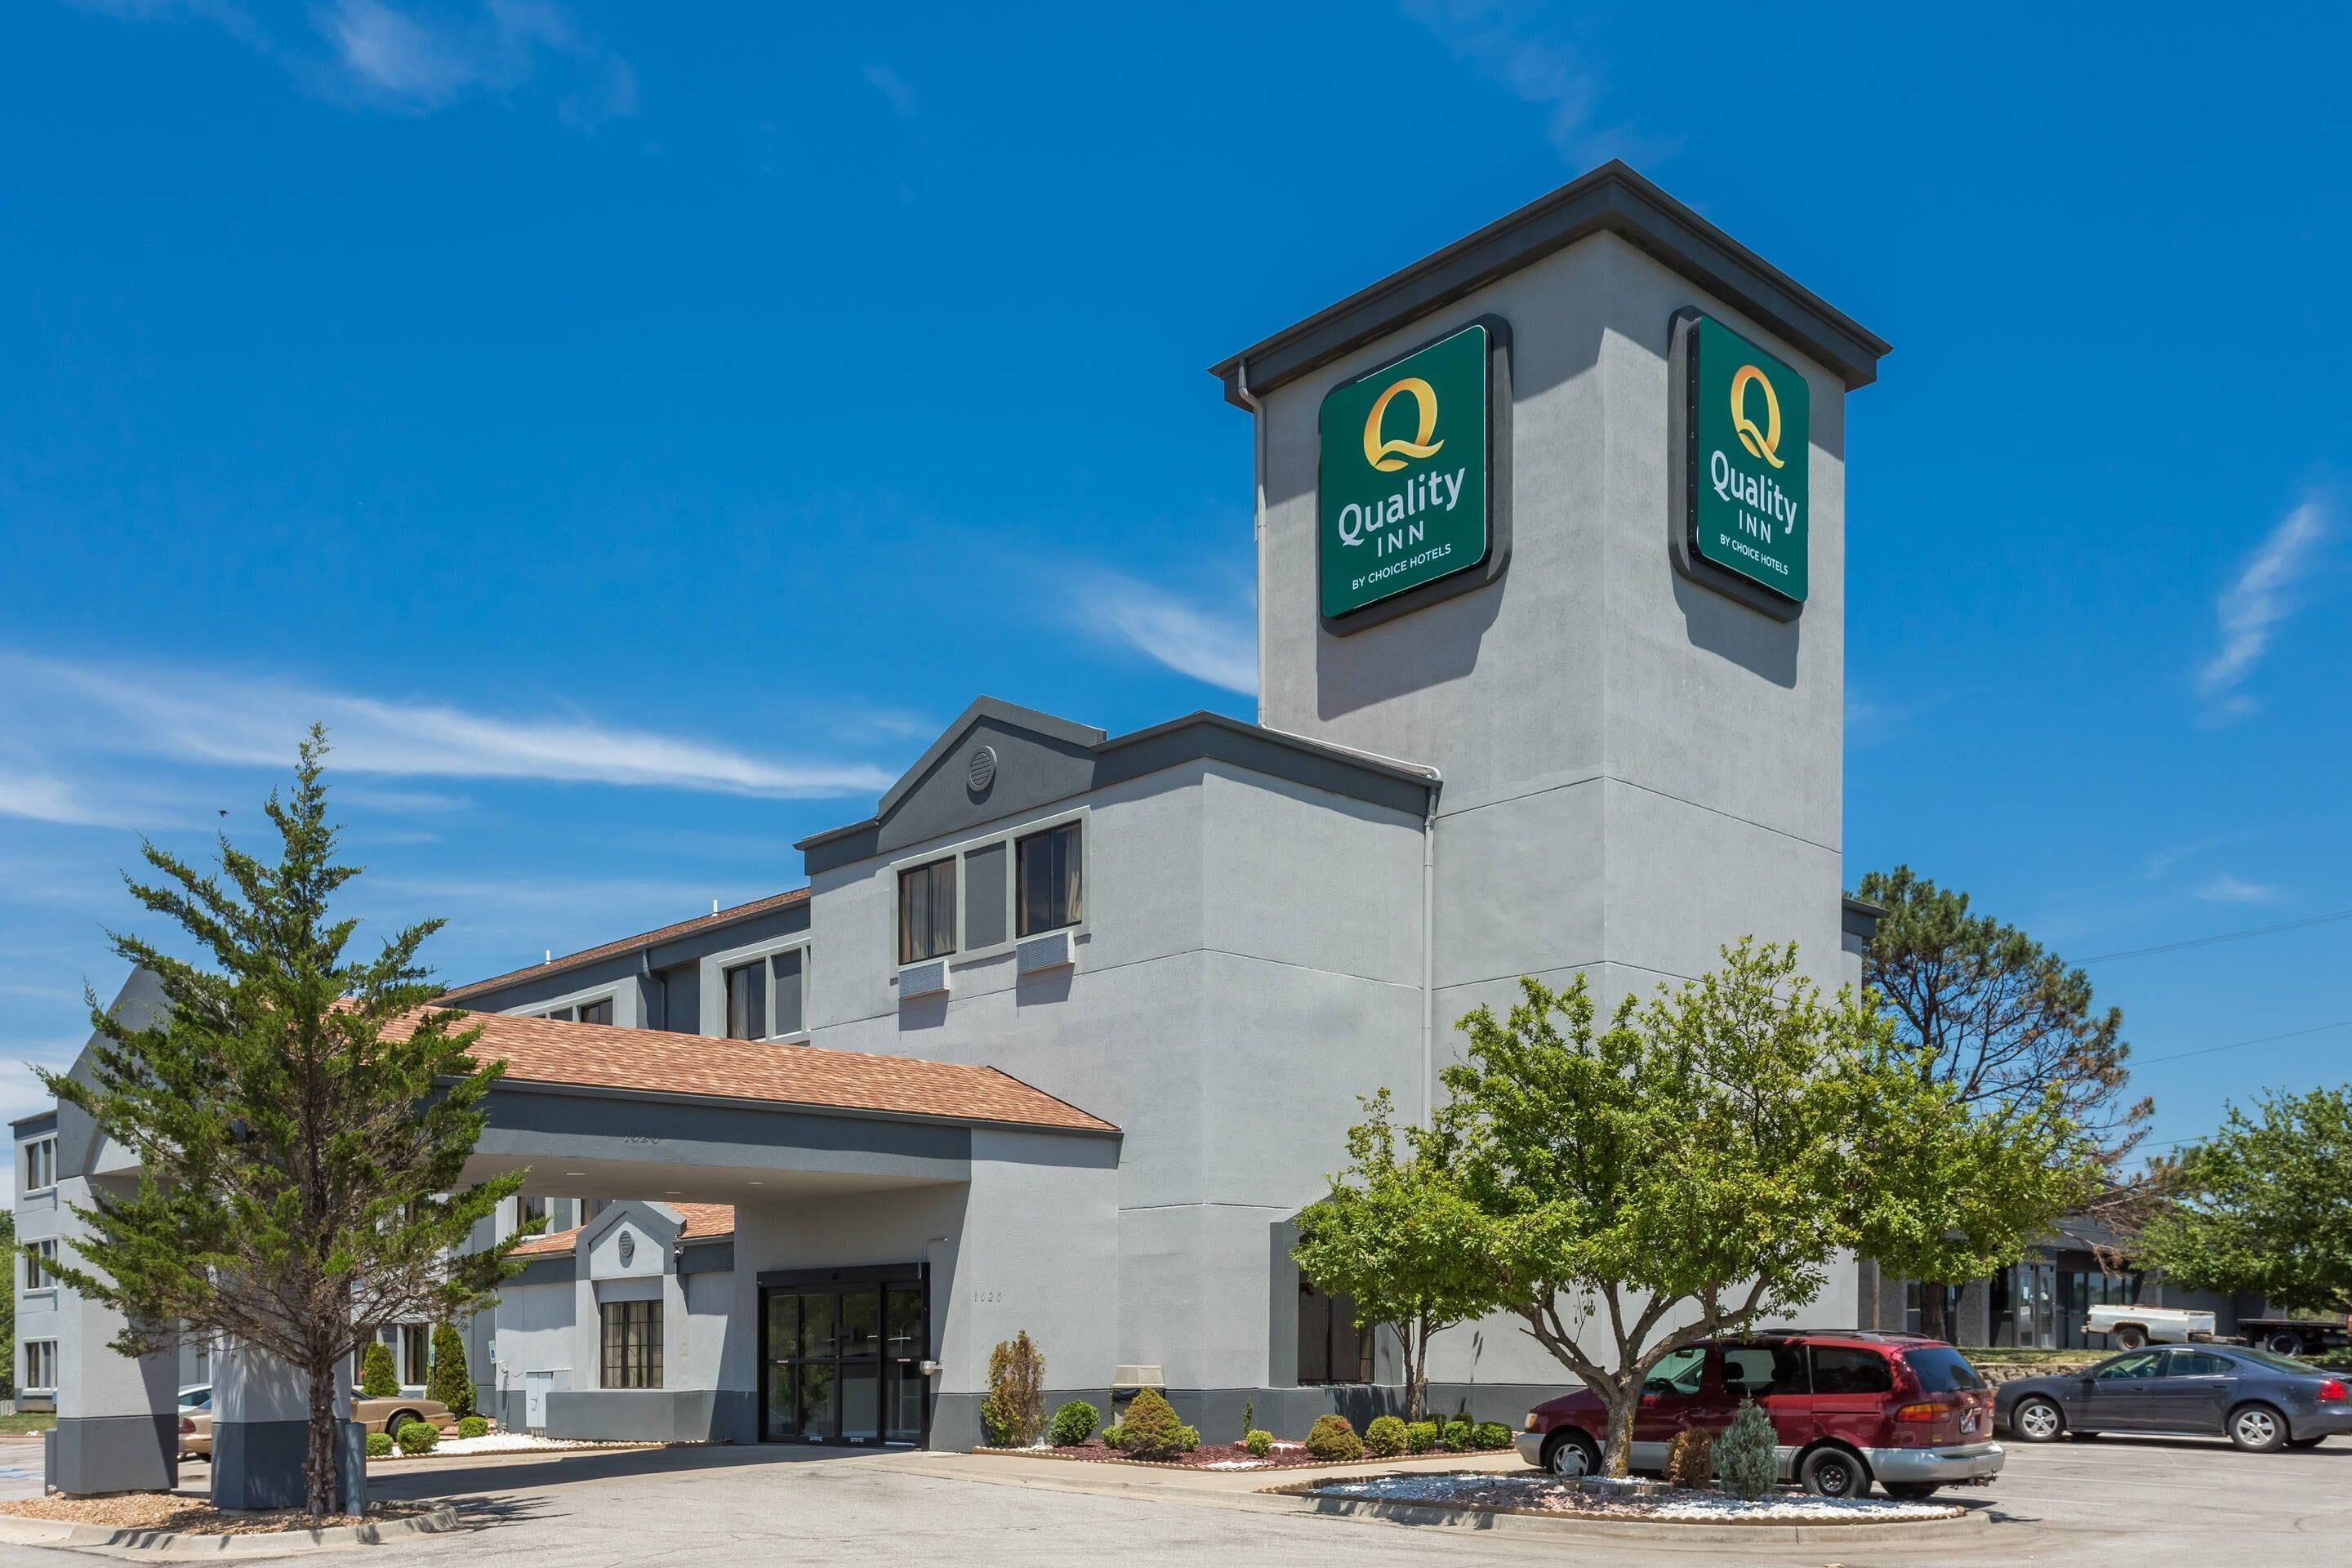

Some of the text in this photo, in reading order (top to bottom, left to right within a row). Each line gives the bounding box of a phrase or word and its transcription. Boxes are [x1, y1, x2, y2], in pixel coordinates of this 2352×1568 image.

[1339, 467, 1465, 546] Quality
[1711, 450, 1797, 535] Quality
[1378, 520, 1423, 557] INN
[1739, 509, 1771, 544] INN
[1352, 543, 1452, 590] BY CHOICE HOTELS
[1720, 533, 1788, 575] BY CHOICE HOTELS
